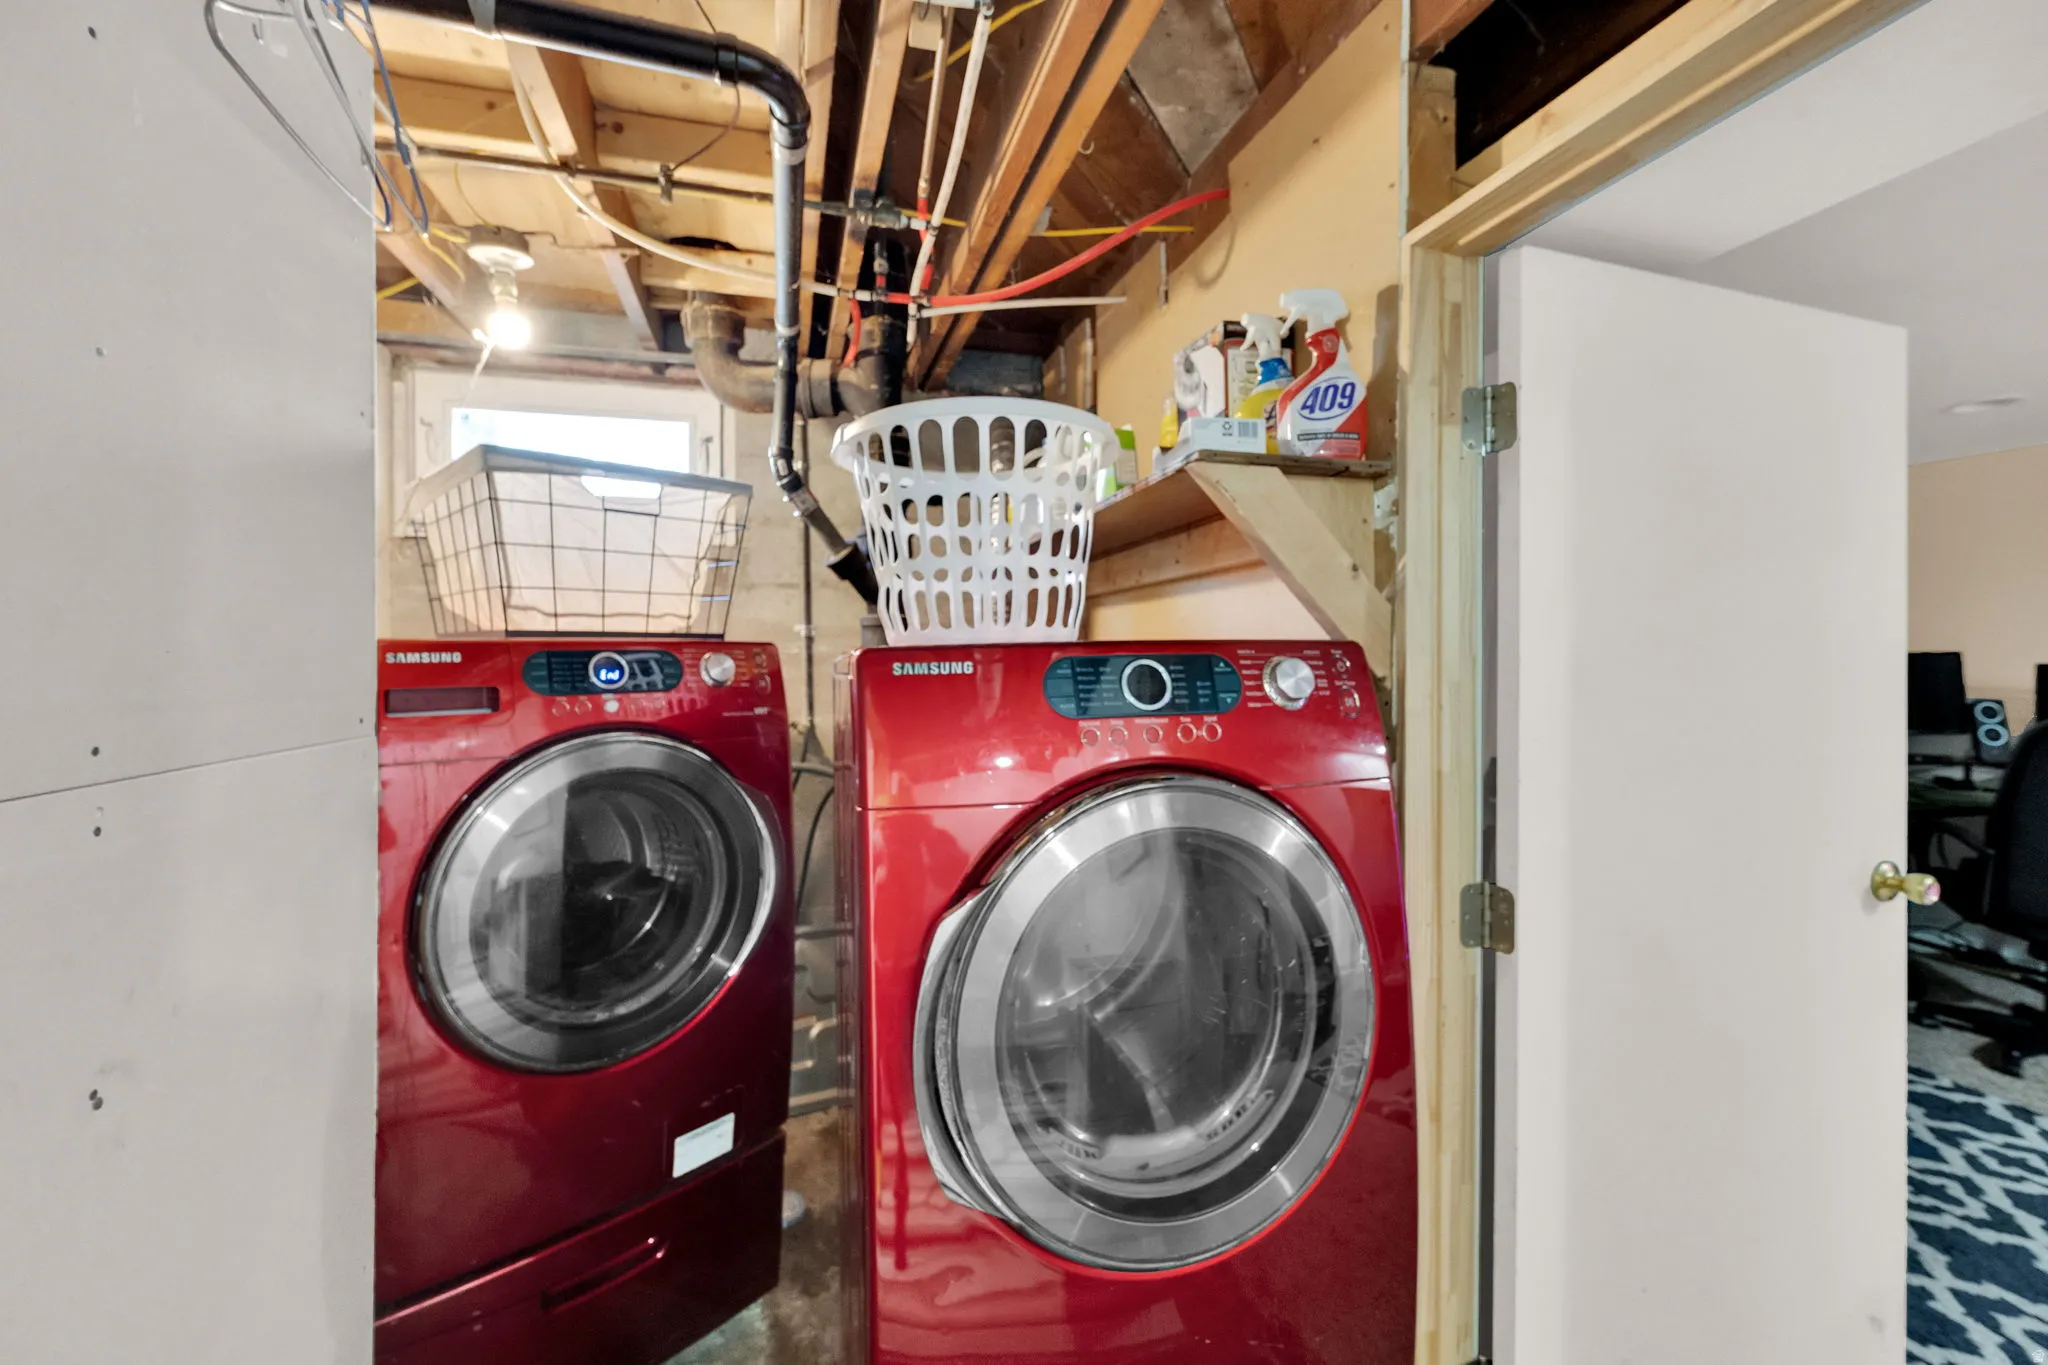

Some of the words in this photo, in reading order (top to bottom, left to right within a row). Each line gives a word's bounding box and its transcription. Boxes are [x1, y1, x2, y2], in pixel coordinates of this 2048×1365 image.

[1300, 382, 1356, 414] 409
[385, 651, 462, 664] SAMSUNG
[892, 661, 974, 676] SAMSUNG
